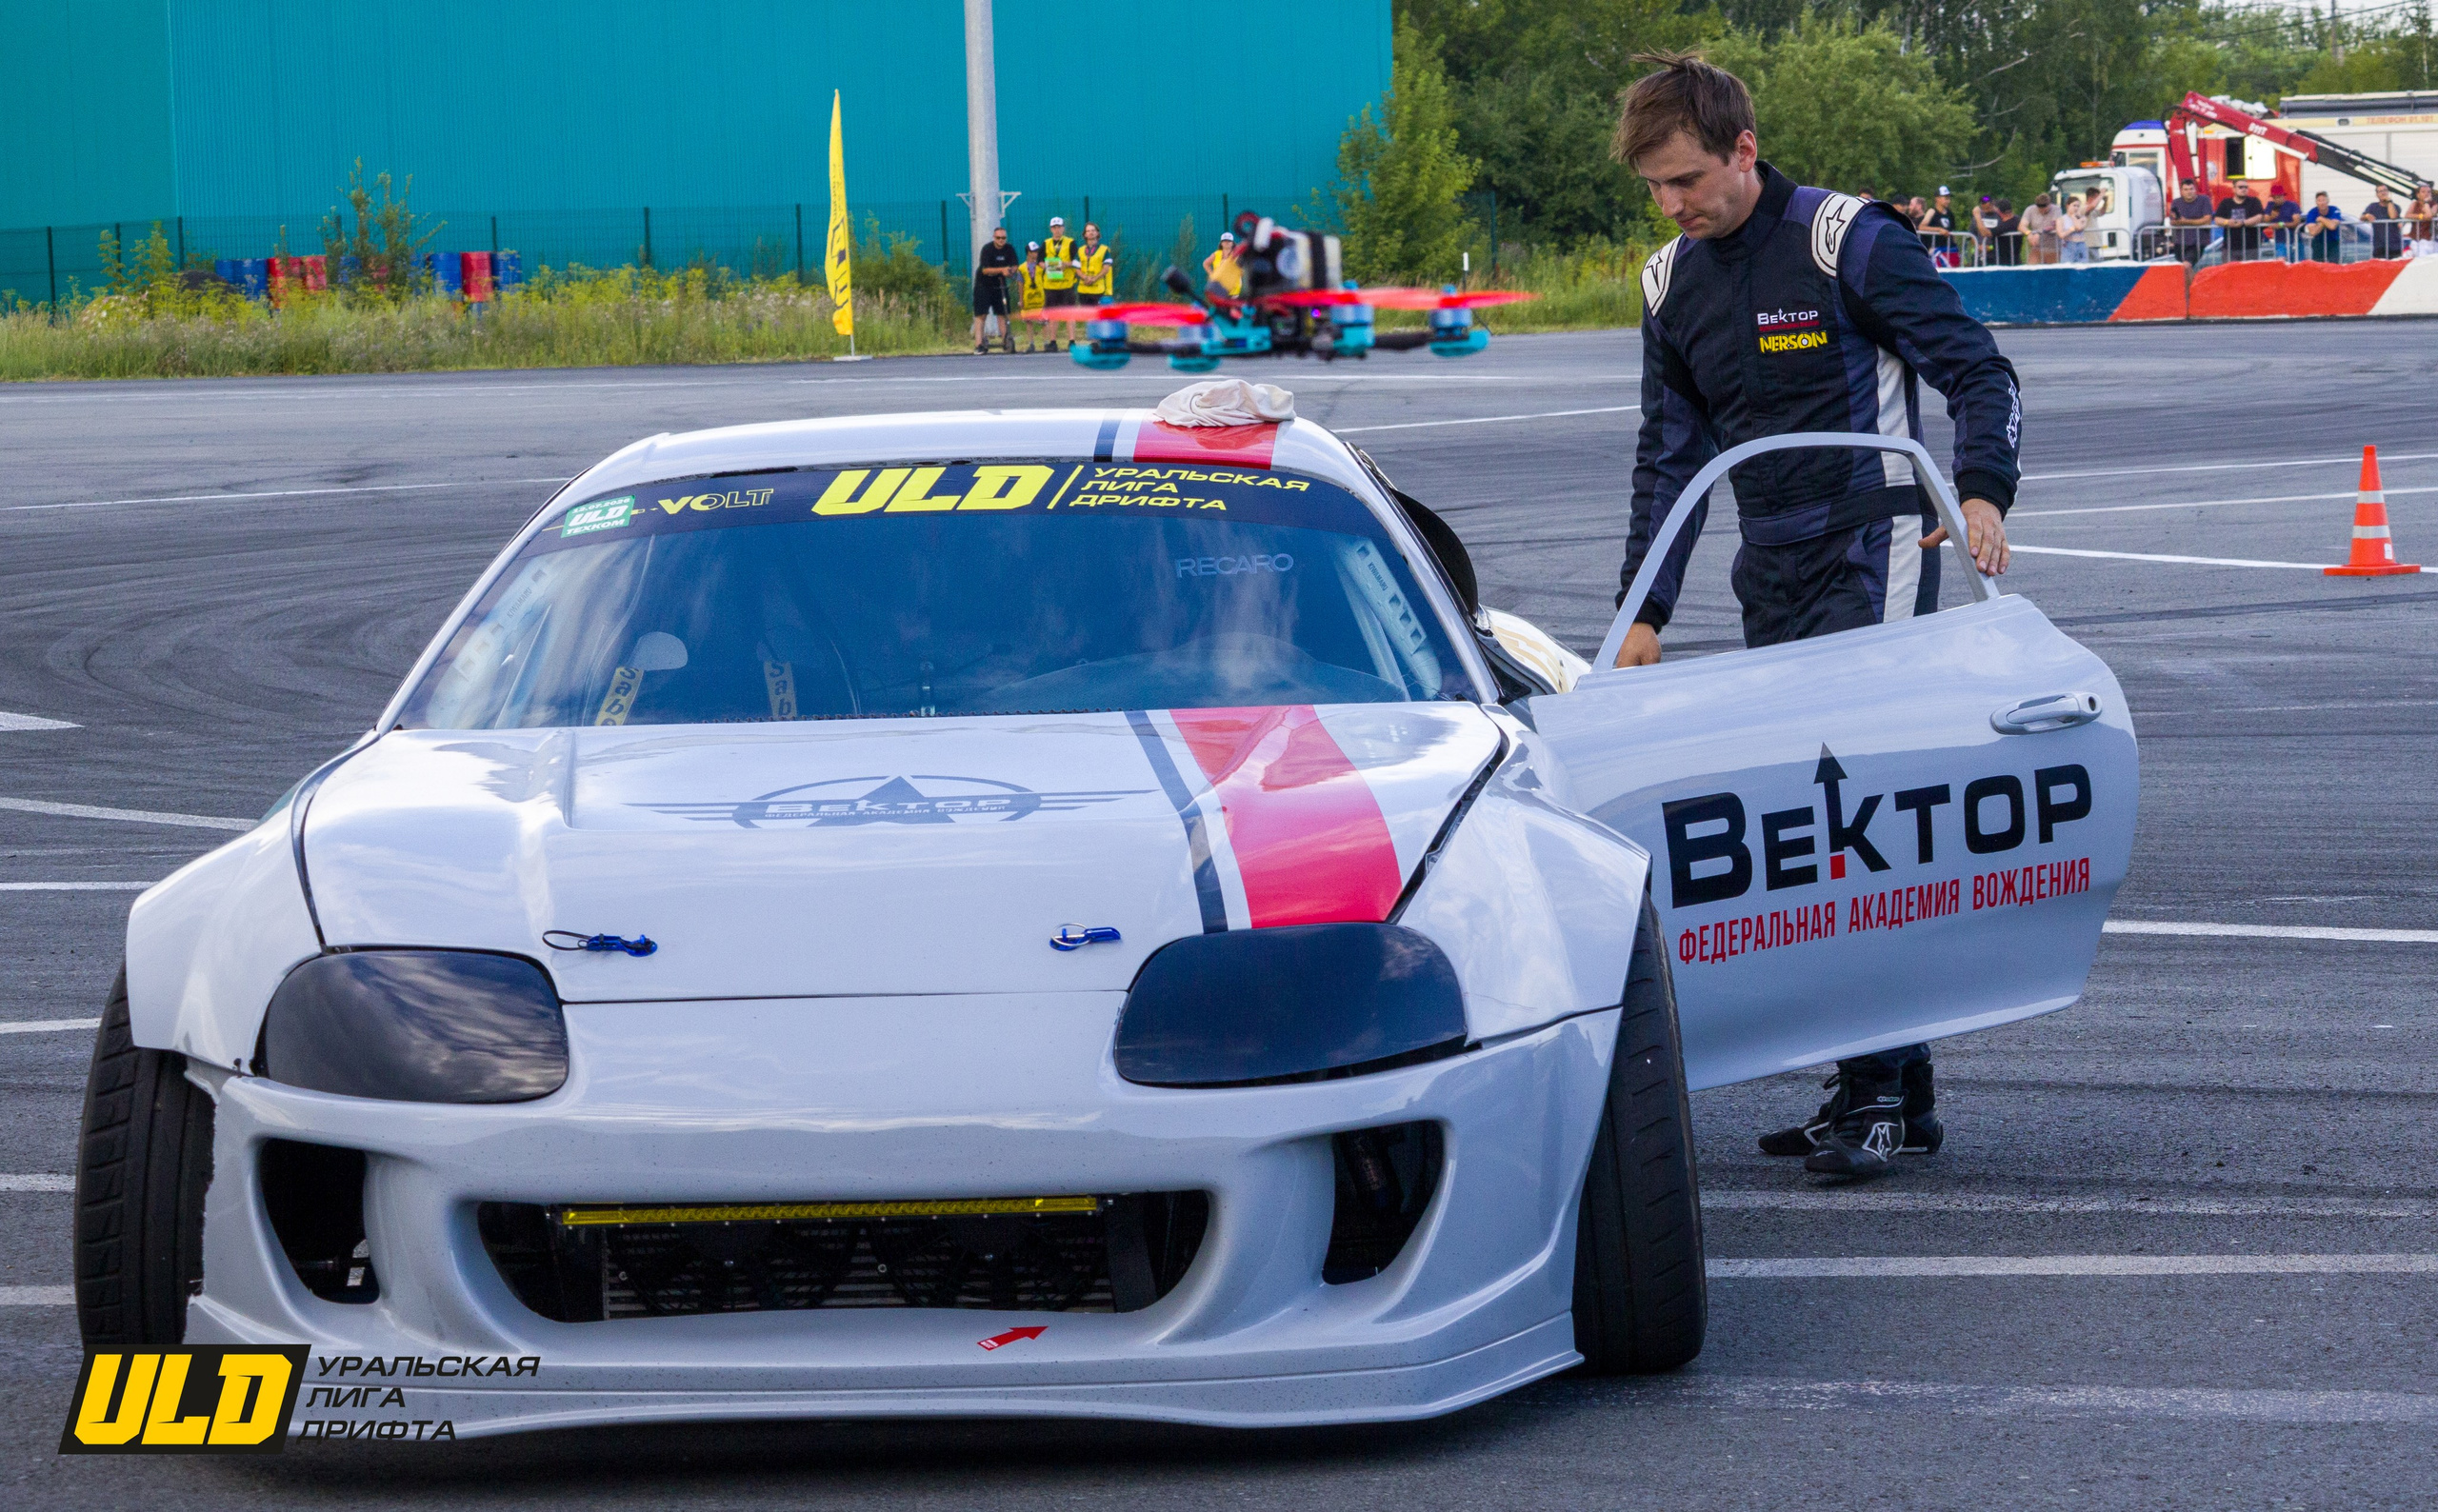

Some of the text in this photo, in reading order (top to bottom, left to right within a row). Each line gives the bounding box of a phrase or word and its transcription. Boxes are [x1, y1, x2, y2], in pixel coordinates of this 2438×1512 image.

[1759, 331, 1828, 353] NERSON
[811, 465, 1055, 516] ULD
[1080, 480, 1178, 493] ЛИГА
[1094, 468, 1310, 492] УРАЛЬСКАЯ
[657, 488, 774, 515] VOLT
[1069, 494, 1227, 510] ДРИФТА
[567, 519, 626, 535] ТЕХКОМ
[568, 505, 629, 527] ULD
[1175, 553, 1294, 578] RECARO
[1678, 857, 2090, 965] ФЕДЕРАЛЬНАЯ АКАДЕМИЯ ВОЖДЕНИЯ
